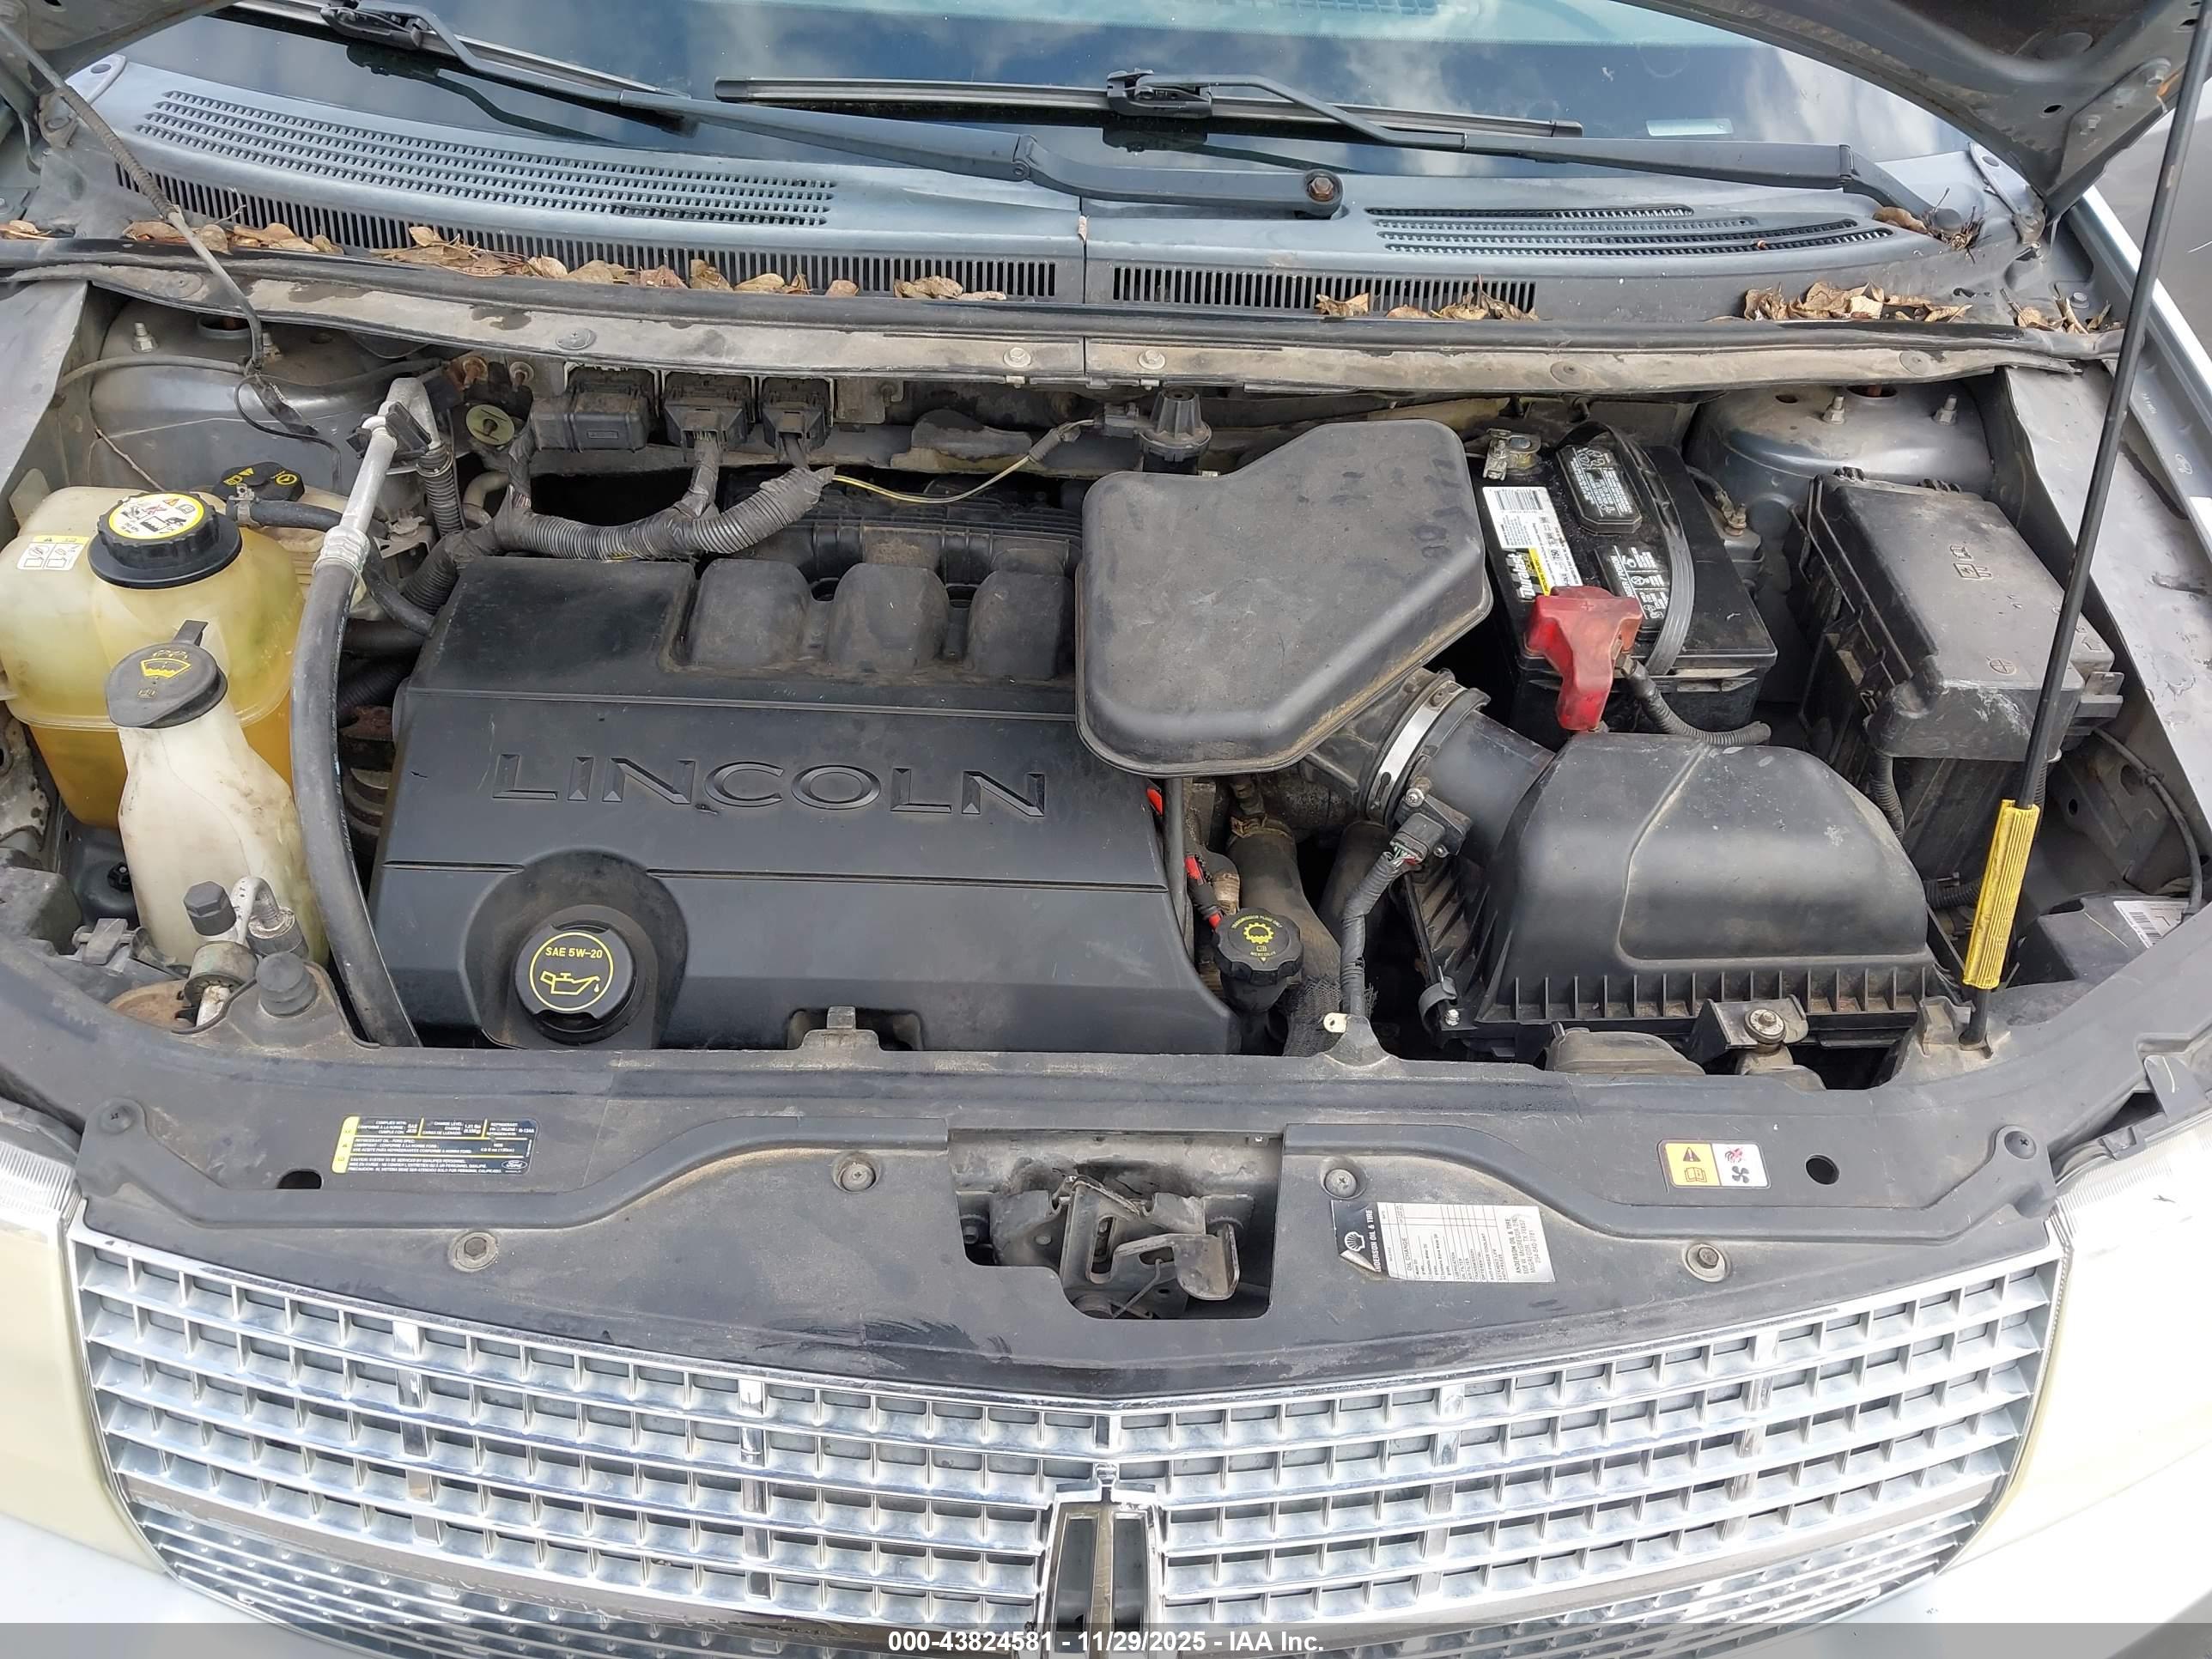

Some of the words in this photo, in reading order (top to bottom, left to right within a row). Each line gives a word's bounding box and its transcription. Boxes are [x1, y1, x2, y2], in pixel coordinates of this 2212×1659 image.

[1508, 553, 1536, 599] Duralast
[493, 754, 1045, 817] LINCOLN
[545, 946, 566, 957] SAE
[568, 947, 603, 958] 5W-20
[1402, 1237, 1411, 1261] CHANGE
[1511, 1245, 1522, 1273] ANDERSON
